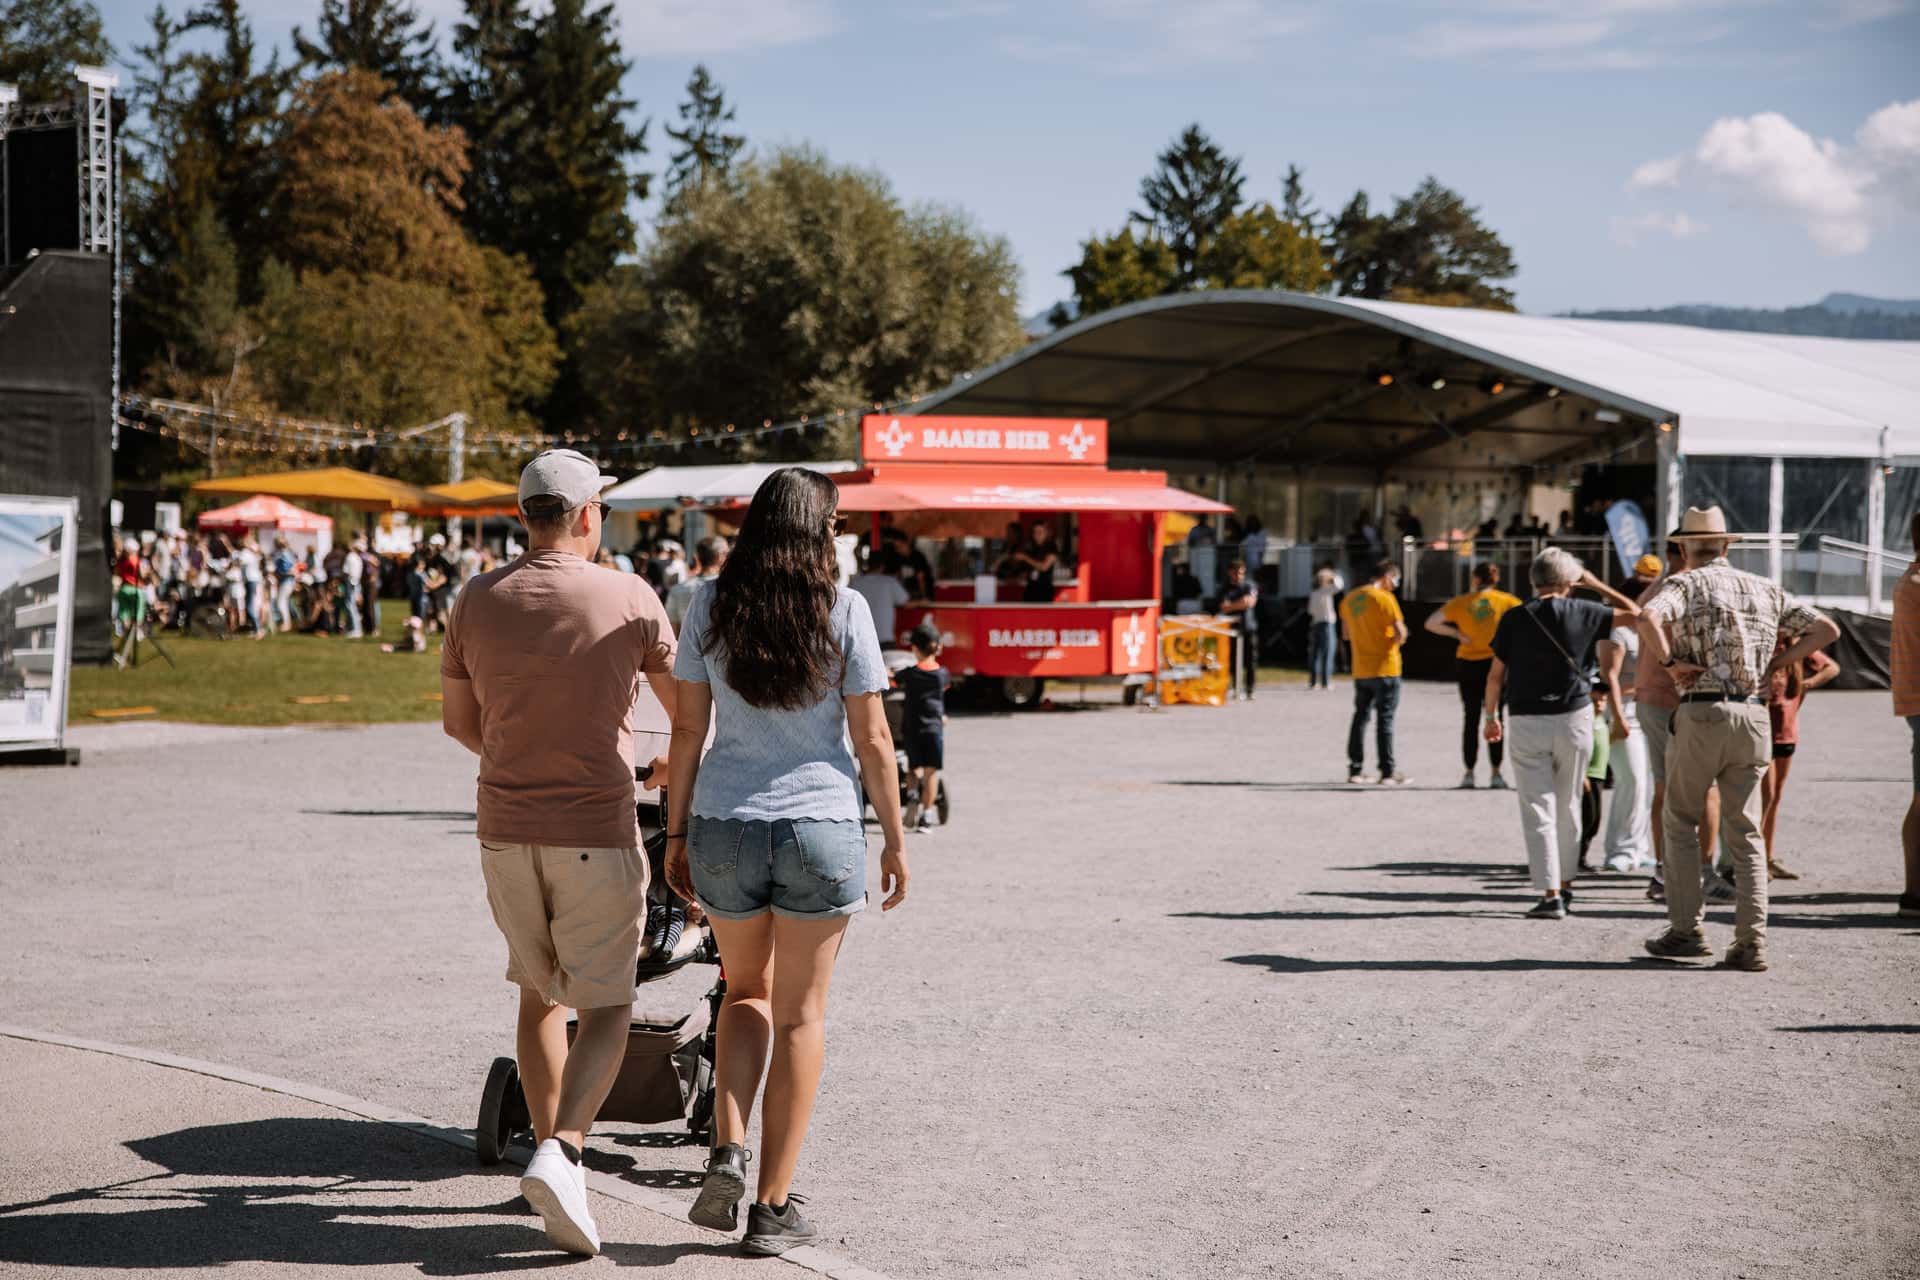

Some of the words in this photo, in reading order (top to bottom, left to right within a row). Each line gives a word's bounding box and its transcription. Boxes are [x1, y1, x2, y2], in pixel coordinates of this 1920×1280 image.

[922, 429, 1002, 448] BAARER
[1005, 430, 1051, 450] BIER
[988, 629, 1056, 647] BAARER
[1060, 629, 1100, 647] BIER
